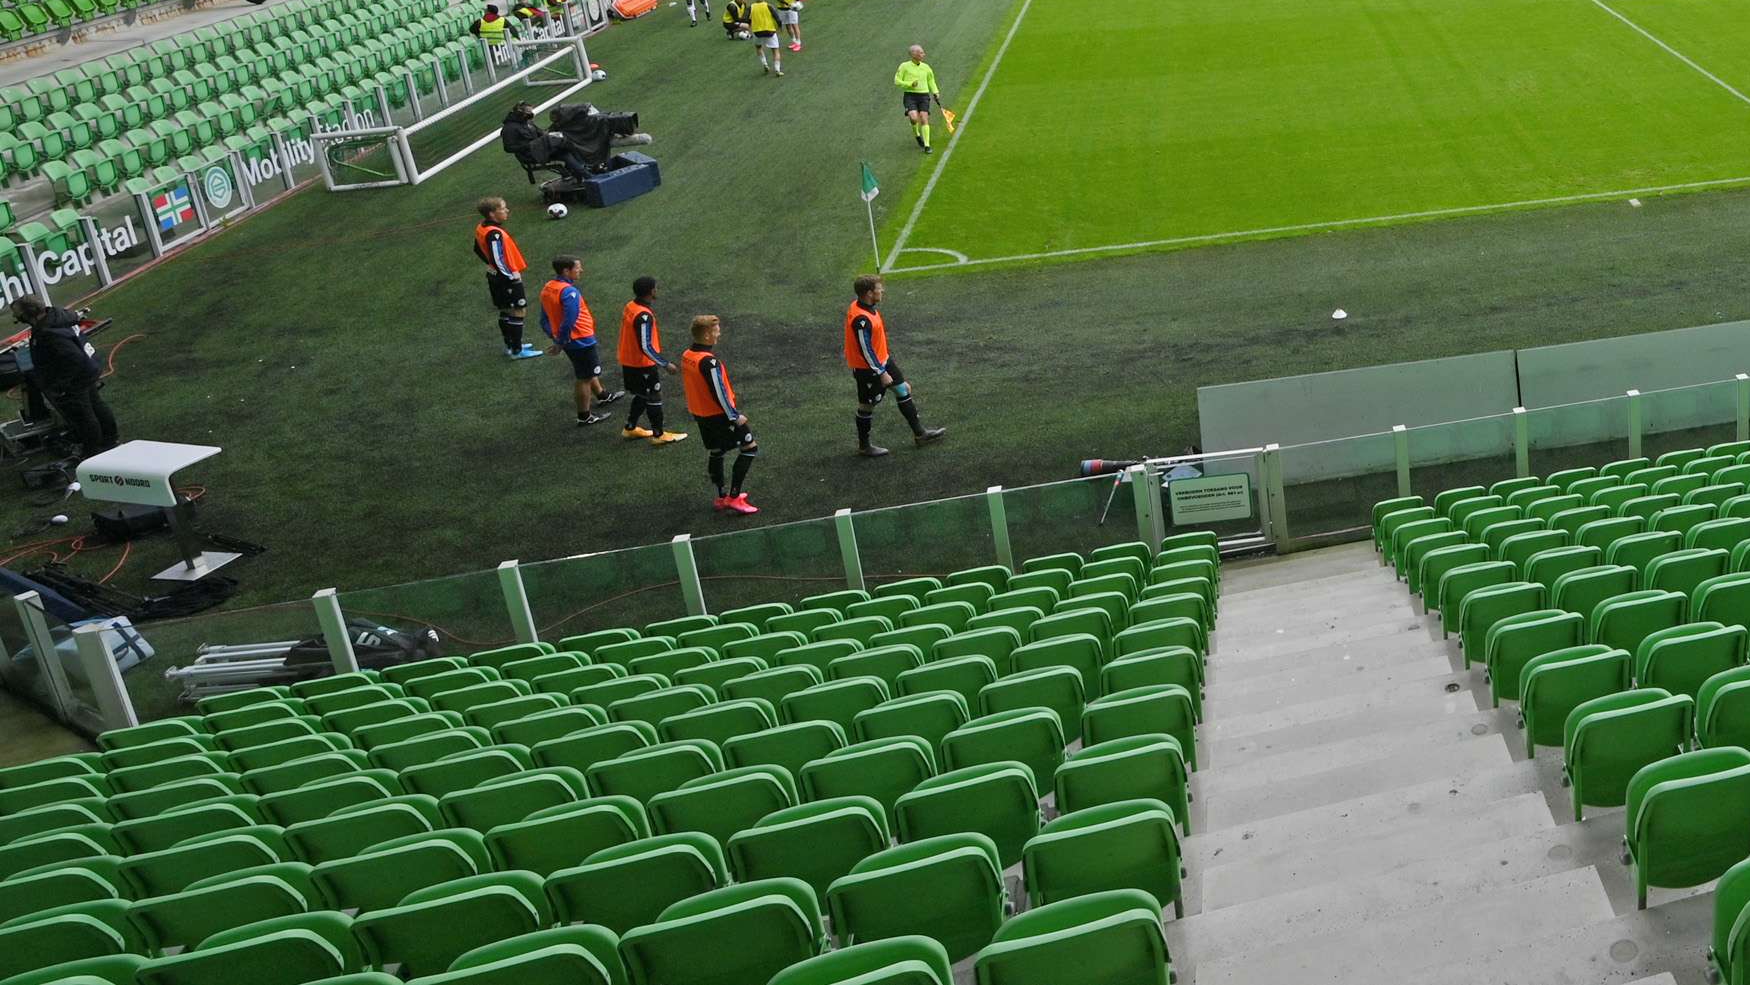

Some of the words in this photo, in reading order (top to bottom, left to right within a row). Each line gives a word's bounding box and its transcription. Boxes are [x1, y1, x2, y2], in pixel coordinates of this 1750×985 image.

[37, 215, 138, 285] Captal
[89, 474, 113, 484] SPORT
[125, 478, 151, 488] NOORD
